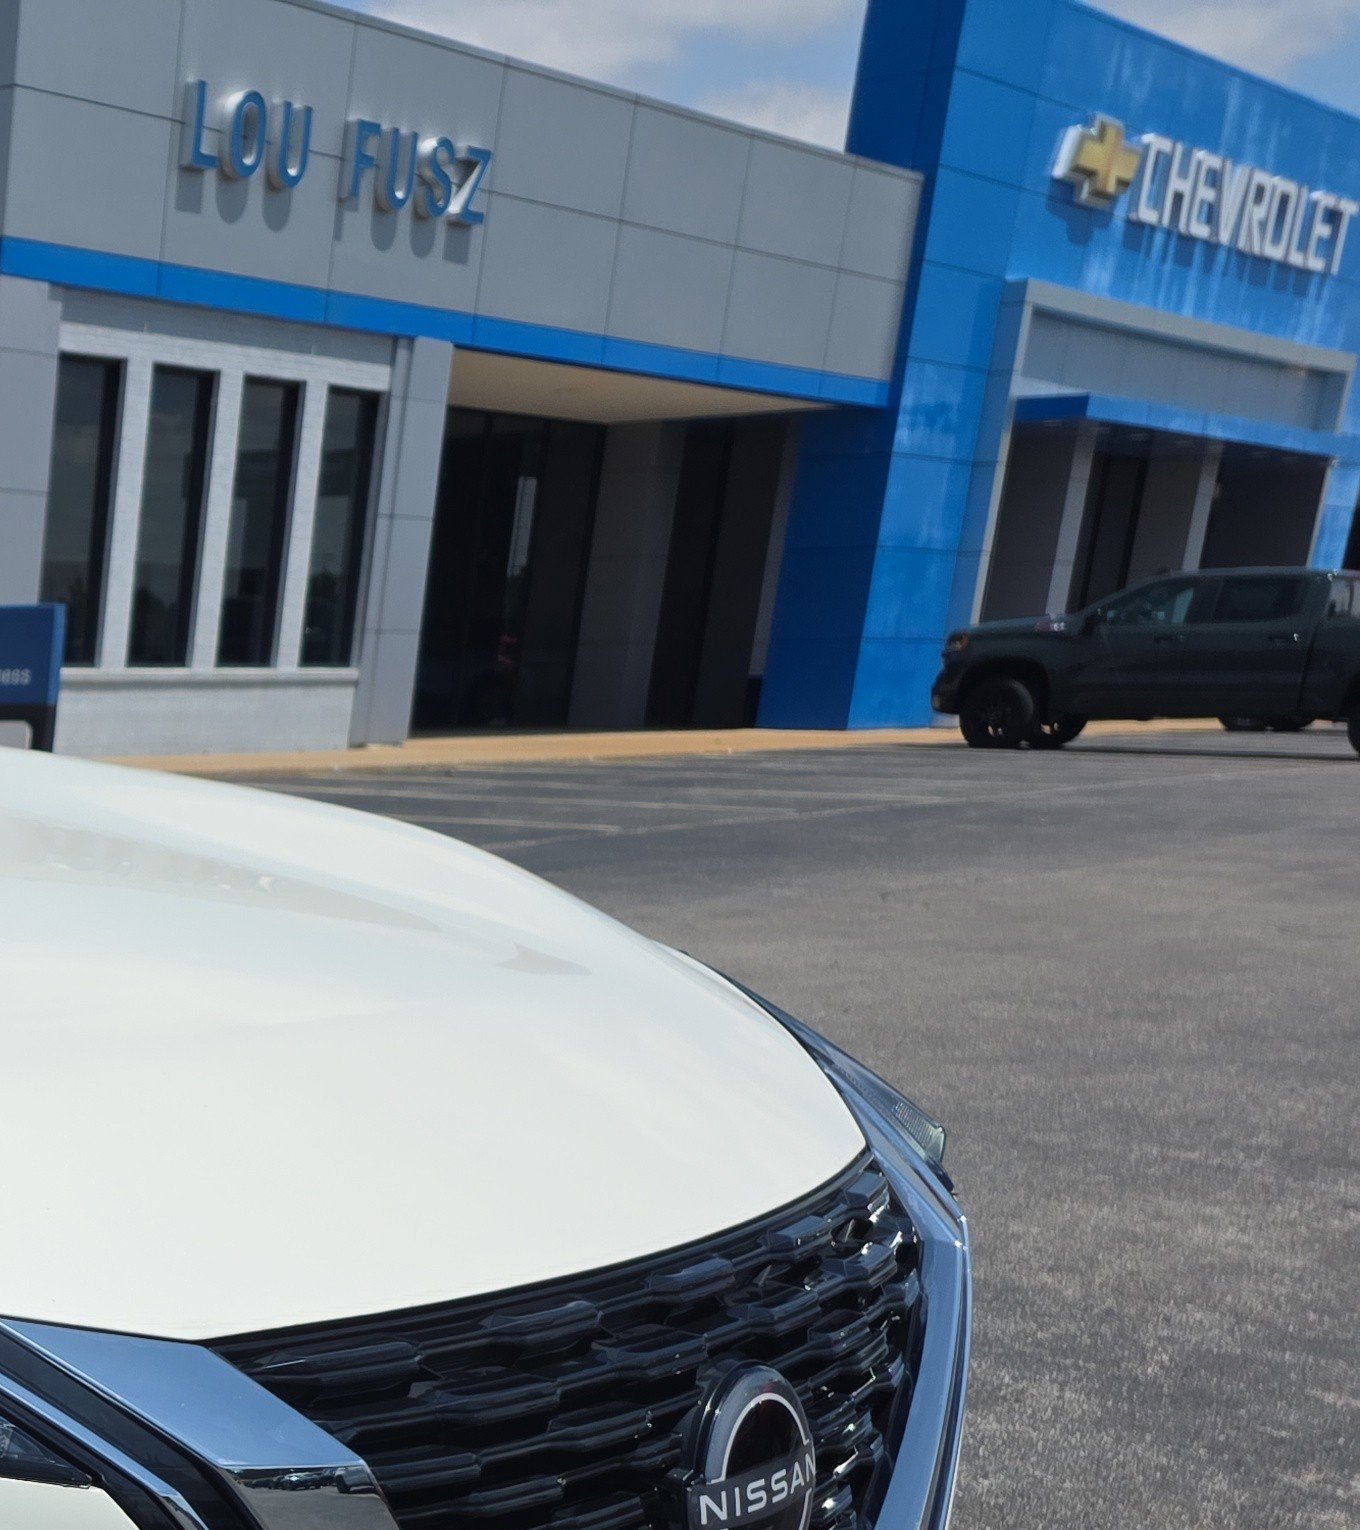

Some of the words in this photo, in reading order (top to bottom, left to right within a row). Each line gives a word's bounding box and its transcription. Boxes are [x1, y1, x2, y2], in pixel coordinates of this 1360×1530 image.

[184, 79, 313, 189] LOU
[344, 117, 493, 226] FUSZ
[1134, 133, 1359, 276] CHEVROLET
[699, 1453, 816, 1526] NISSAN
